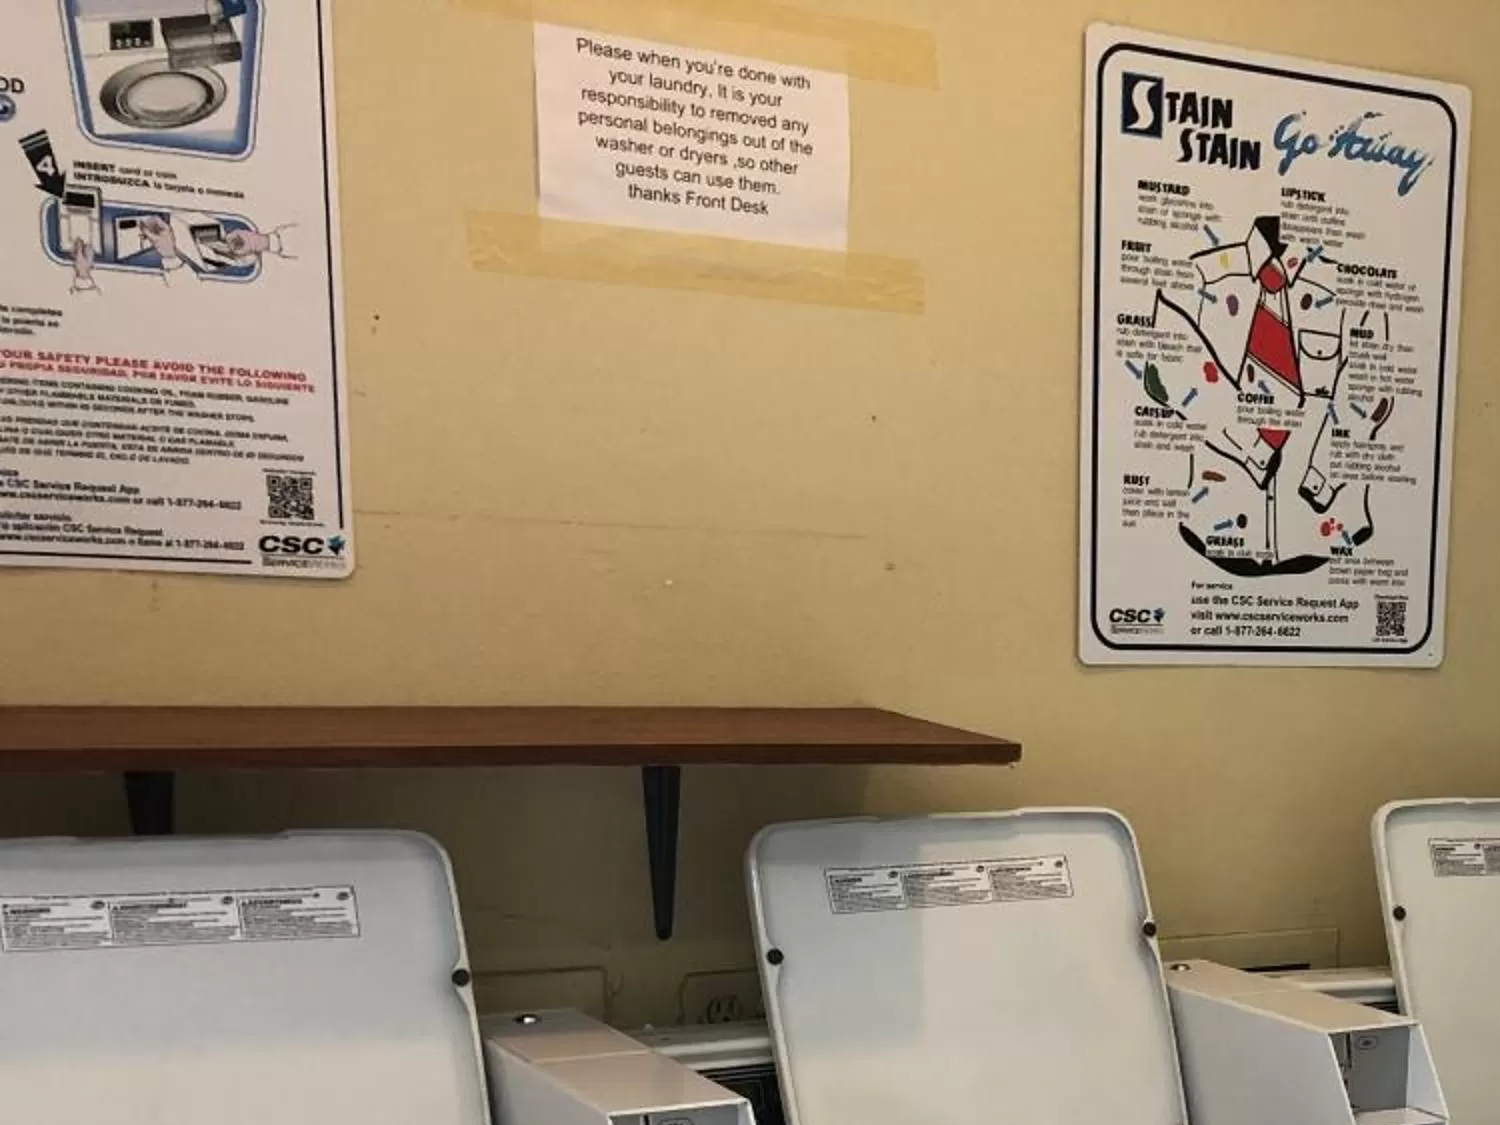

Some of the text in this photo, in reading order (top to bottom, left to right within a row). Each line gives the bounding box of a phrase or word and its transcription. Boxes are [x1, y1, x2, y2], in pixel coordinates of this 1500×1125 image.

[576, 37, 810, 89] Please when you're done with
[608, 70, 782, 106] your laundry. It is your
[581, 88, 808, 135] responsibility to removed any
[1125, 76, 1234, 133] STAIN
[577, 111, 813, 155] personal belongings out of the
[1177, 128, 1262, 171] STAIN
[1273, 111, 1317, 177] Go
[595, 136, 798, 174] washer or dryers ,so other
[36, 154, 57, 178] 4
[615, 161, 779, 194] guests can use them.
[1138, 180, 1191, 197] MUSTARD
[1281, 187, 1327, 203] LIPSTICK
[628, 183, 768, 215] thanks Front Desk
[1121, 240, 1153, 253] FRUIT
[1337, 263, 1398, 280] CHOCOLATE
[1117, 313, 1152, 328] GRASS
[1350, 327, 1375, 340] MUD
[37, 351, 90, 365] SAFETY
[95, 355, 148, 369] PLEASE
[152, 361, 194, 372] AVOID
[198, 363, 224, 375] THE
[228, 367, 306, 382] FOLLOWING
[1237, 393, 1275, 405] COFFEE
[1331, 428, 1351, 439] INK
[1123, 474, 1152, 486] RUST
[258, 535, 325, 555] CSC
[1206, 535, 1245, 548] GREASE
[1330, 546, 1354, 557] WAX
[1191, 580, 1232, 590] For service
[1191, 595, 1360, 610] use the CSC Service Request App
[1109, 608, 1152, 624] CSC
[1191, 609, 1212, 620] visit
[1189, 626, 1202, 634] or
[1203, 625, 1222, 636] call
